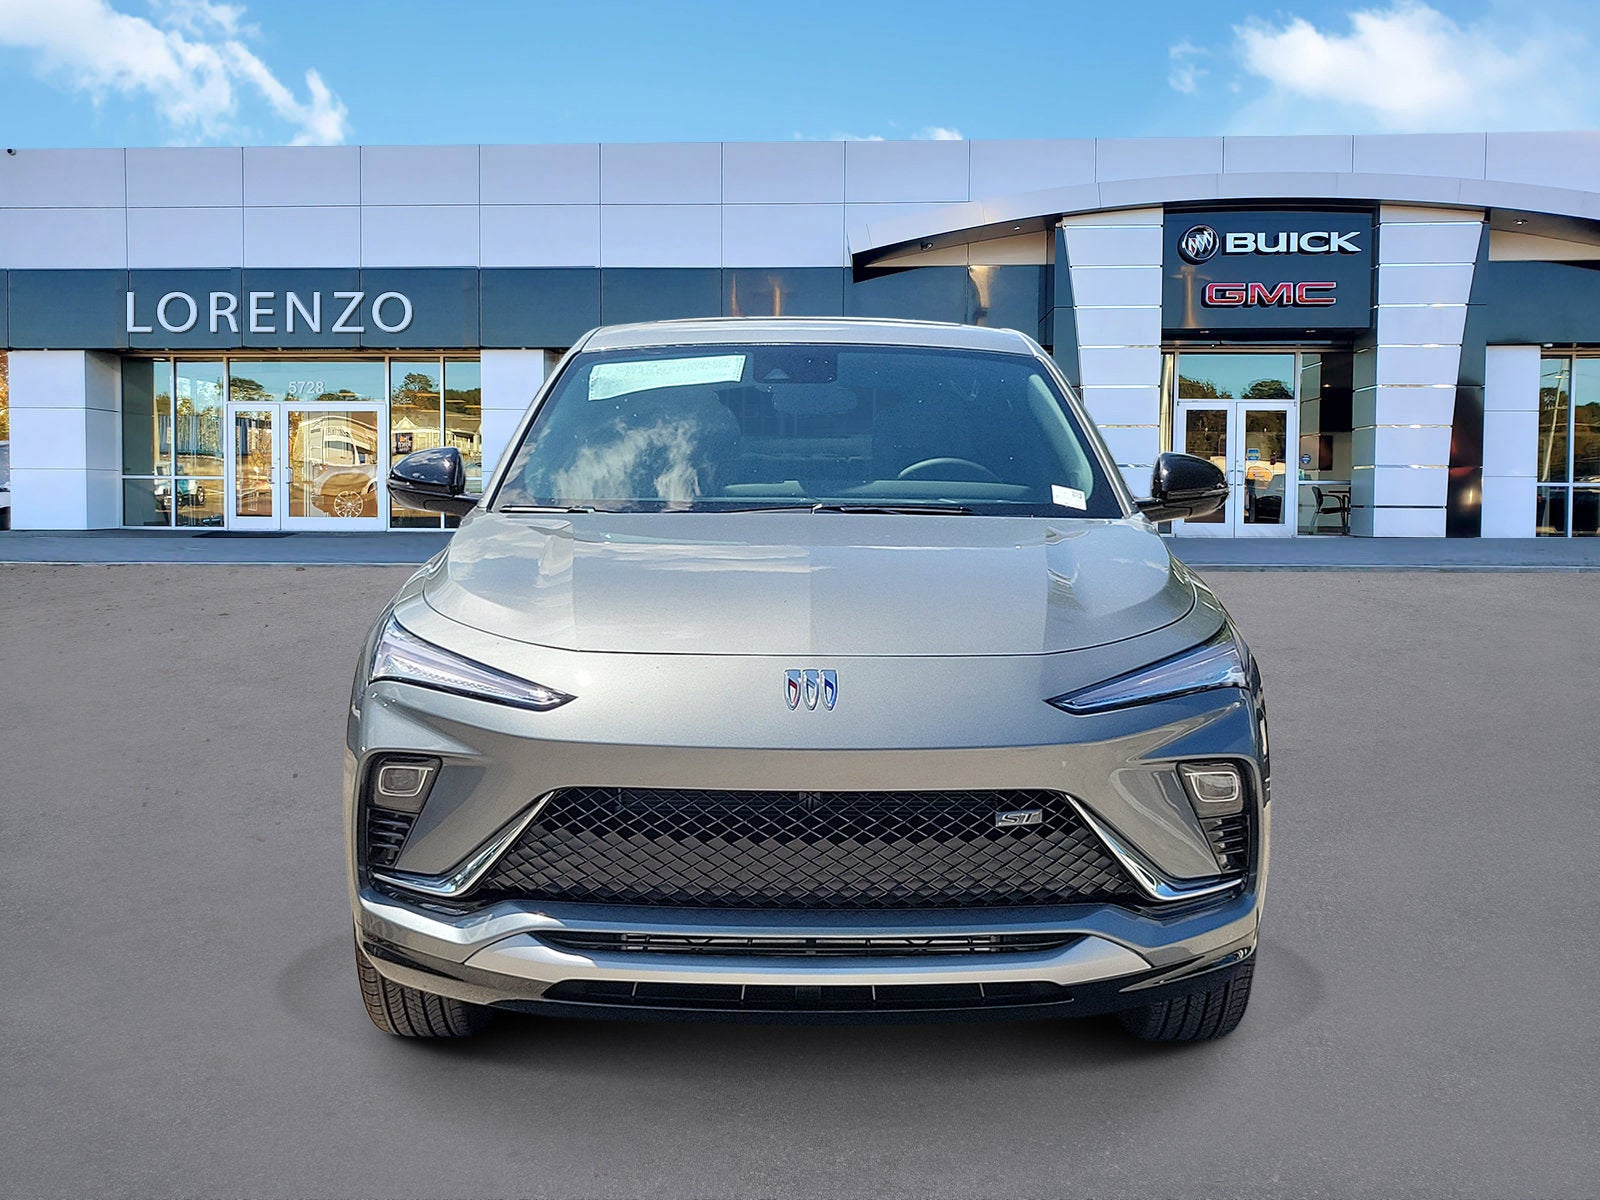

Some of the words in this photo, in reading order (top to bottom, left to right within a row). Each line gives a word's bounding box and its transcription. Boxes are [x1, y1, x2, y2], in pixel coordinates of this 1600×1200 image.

[1225, 231, 1362, 253] BUICK
[1206, 282, 1337, 305] GMC
[126, 291, 413, 333] LORENZO
[289, 380, 325, 394] 5728
[1000, 812, 1041, 825] ST
